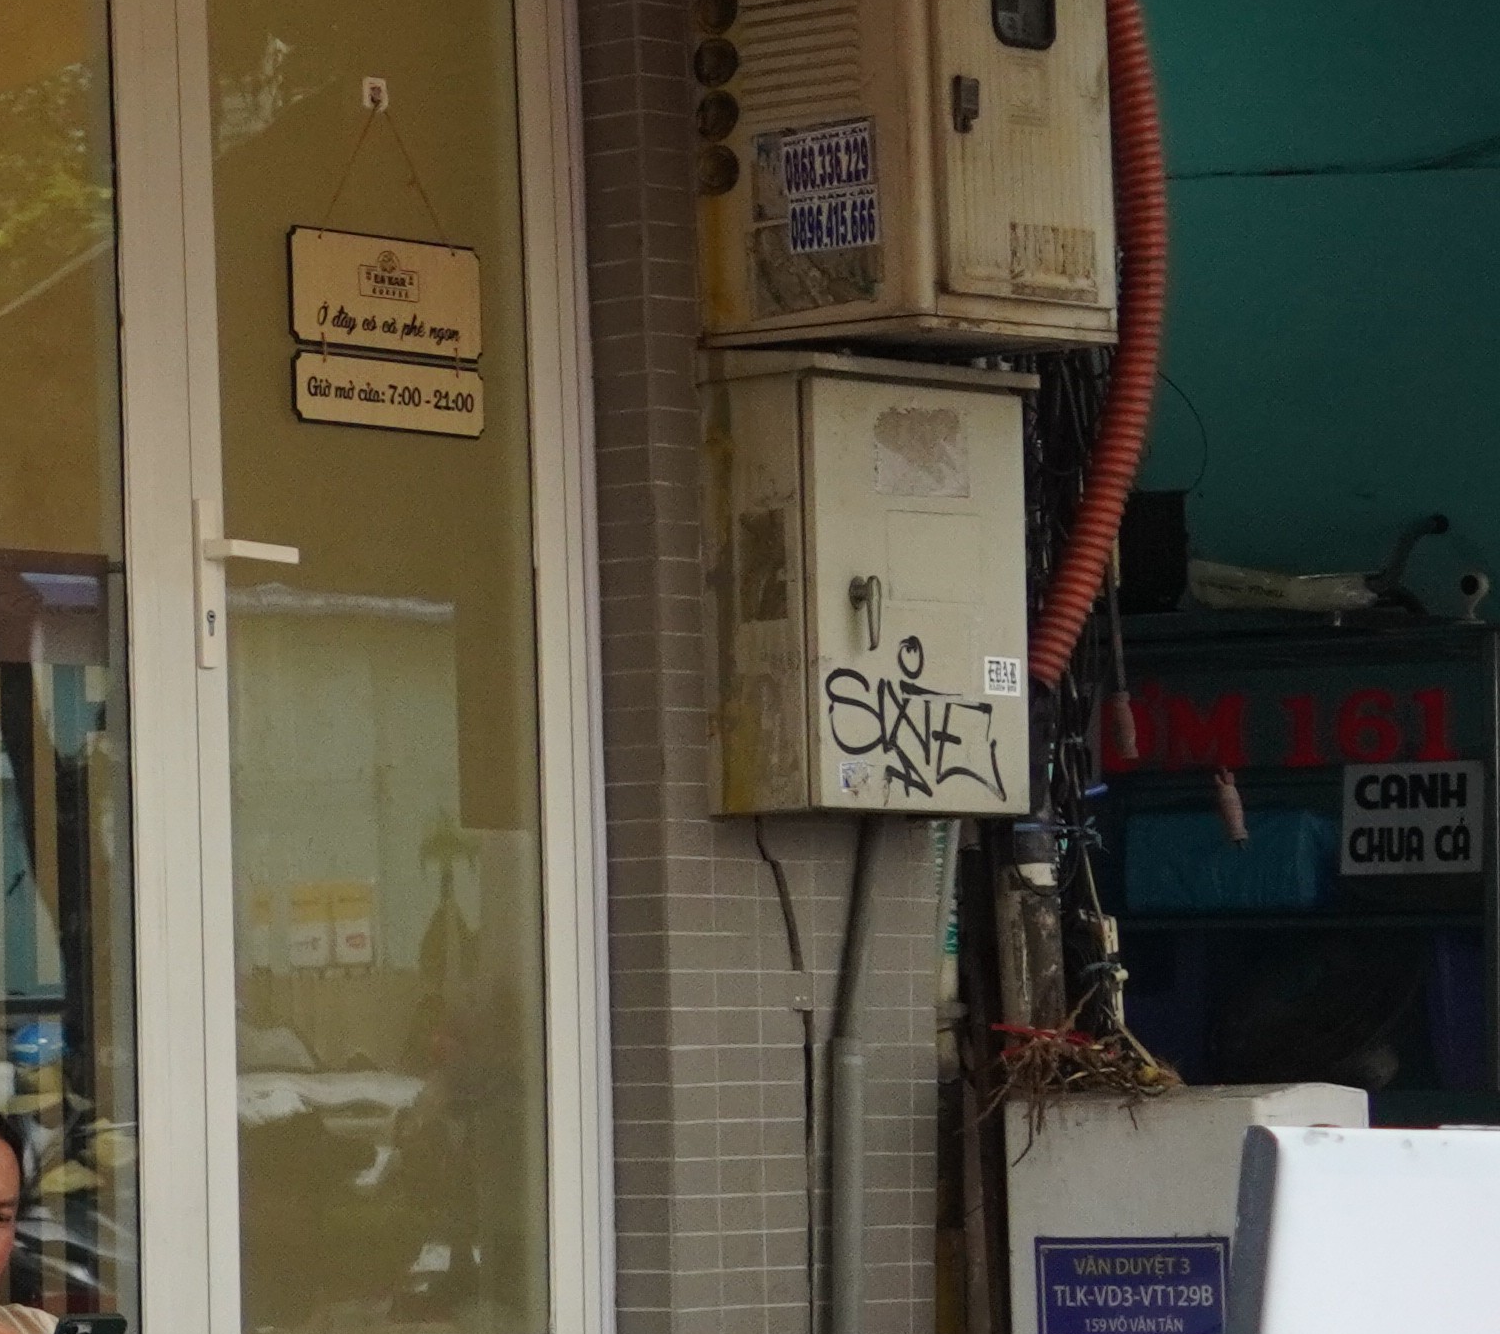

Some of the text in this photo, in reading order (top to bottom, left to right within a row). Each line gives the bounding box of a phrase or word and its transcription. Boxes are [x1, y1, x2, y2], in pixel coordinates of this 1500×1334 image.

[332, 305, 357, 337] đây
[401, 313, 426, 341] phê
[307, 375, 332, 399] Giờ
[334, 380, 355, 400] mở
[358, 382, 385, 404] cửa:
[388, 383, 422, 407] 7:00
[434, 389, 475, 413] 21:00
[1280, 688, 1458, 768] 161
[1354, 772, 1468, 811] CANH
[1349, 826, 1425, 863] CHUA
[1115, 1254, 1176, 1279] DUYỆT
[1180, 1258, 1191, 1275] 3
[1053, 1284, 1214, 1308] TLK-VD3-VT129B
[1084, 1317, 1107, 1333] 159
[1107, 1315, 1128, 1333] VÕ
